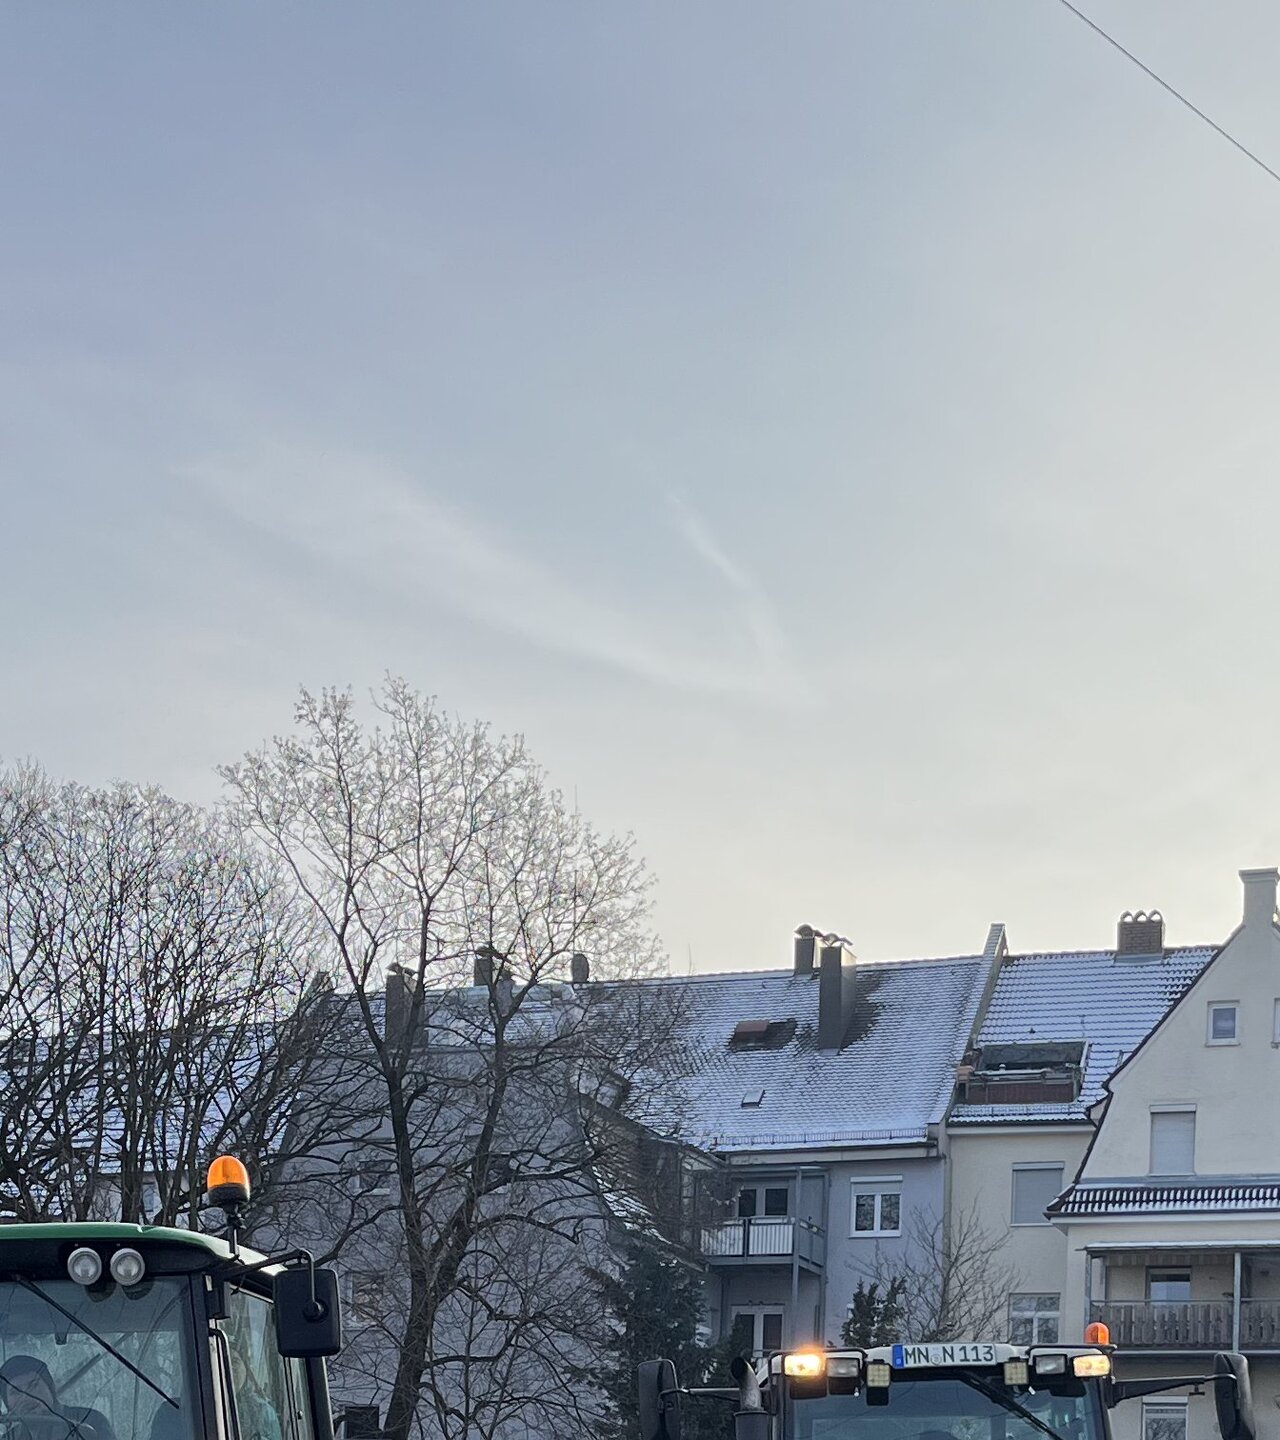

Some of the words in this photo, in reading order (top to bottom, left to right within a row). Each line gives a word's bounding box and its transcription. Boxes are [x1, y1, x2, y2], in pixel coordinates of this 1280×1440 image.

[904, 1347, 929, 1364] MN
[942, 1345, 955, 1362] N
[959, 1345, 993, 1362] 113
